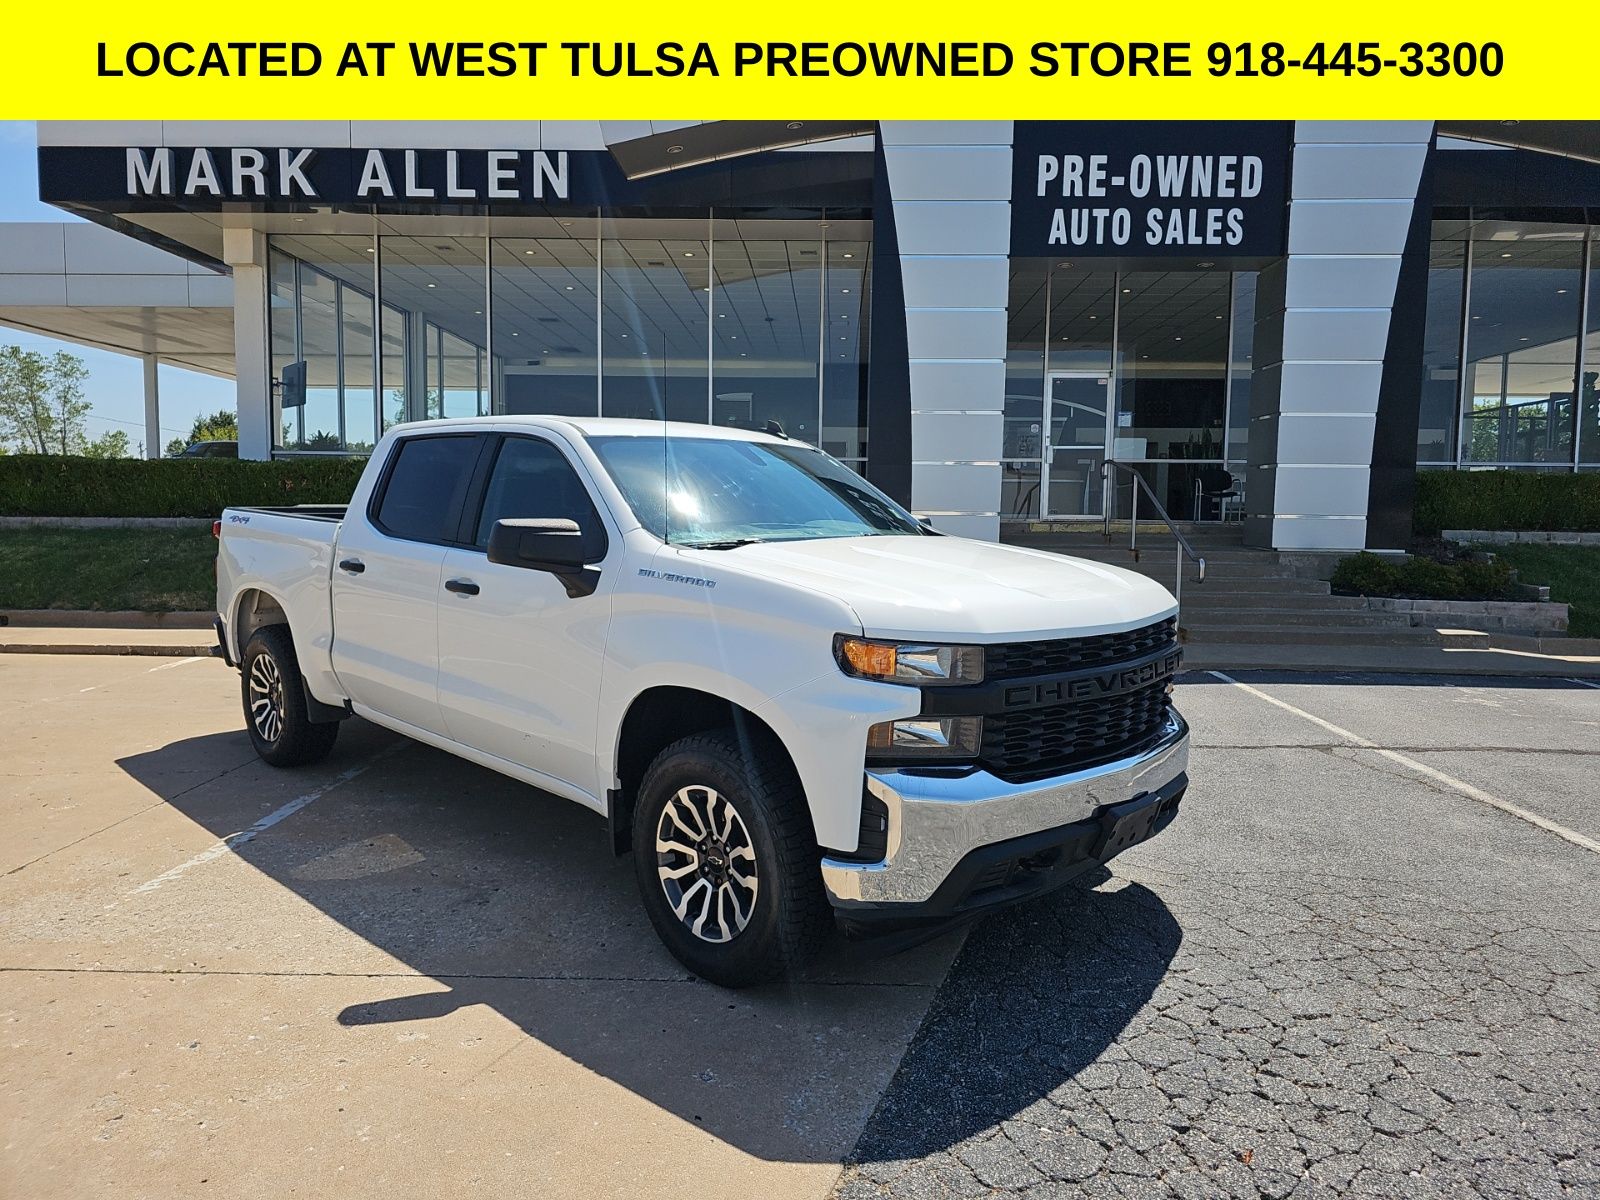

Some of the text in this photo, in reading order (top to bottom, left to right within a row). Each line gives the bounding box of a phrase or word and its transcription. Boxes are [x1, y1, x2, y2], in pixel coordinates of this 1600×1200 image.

[126, 148, 569, 199] MARK ALLEN
[1037, 154, 1263, 198] PRE-OWNED
[1048, 207, 1244, 246] AUTO SALES
[638, 568, 717, 588] SILVERADO
[1004, 651, 1183, 707] CHEVROLET
